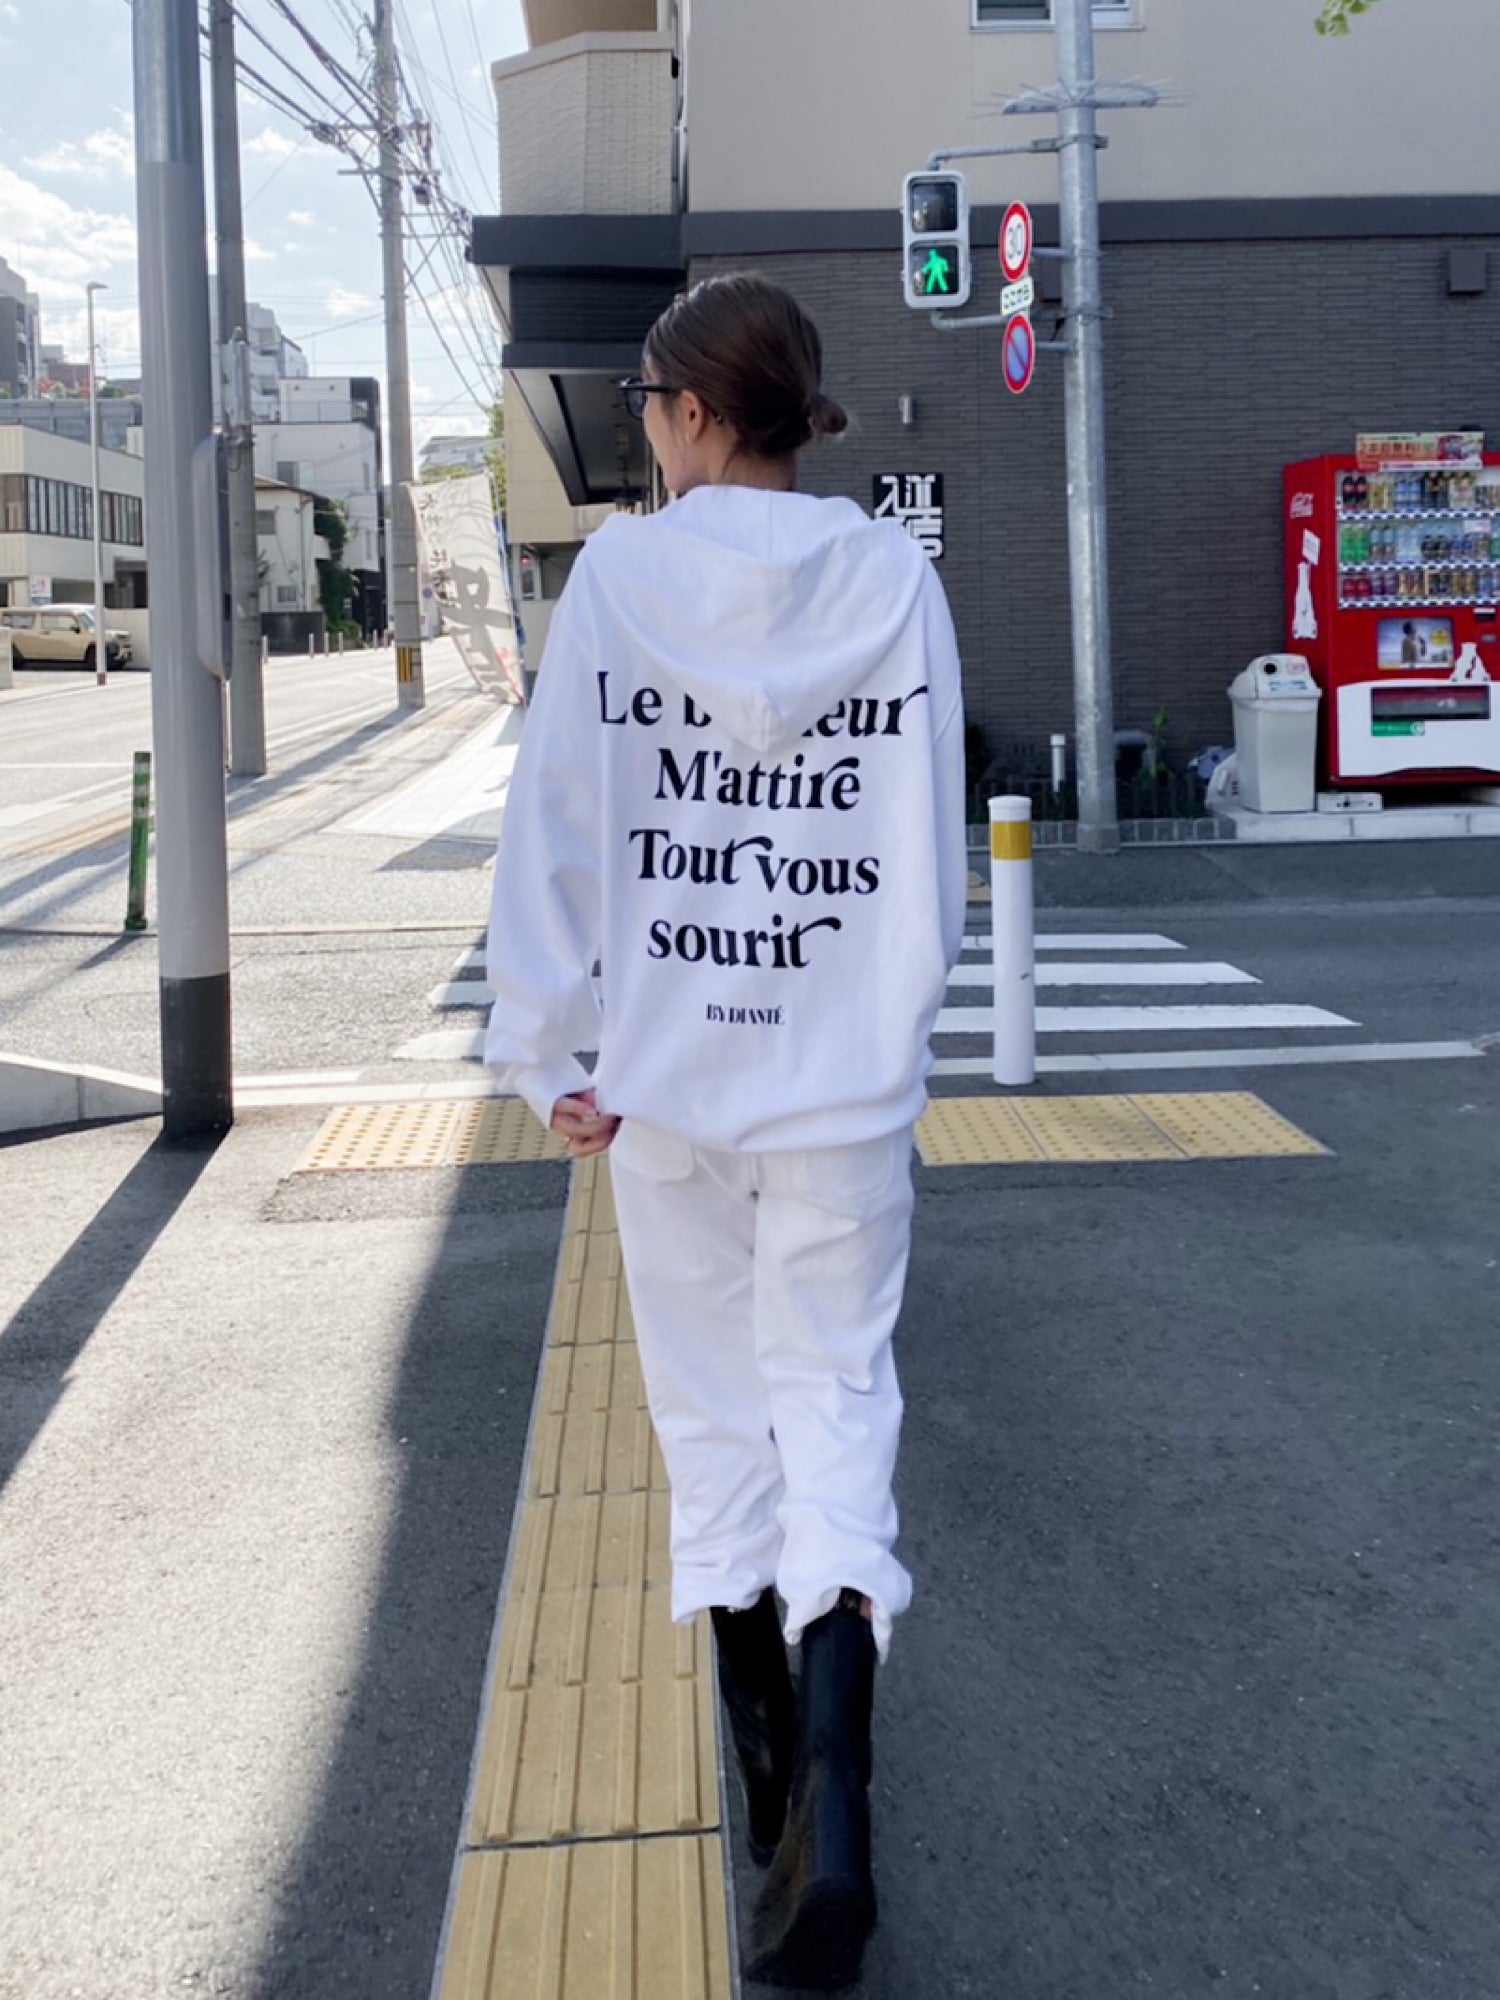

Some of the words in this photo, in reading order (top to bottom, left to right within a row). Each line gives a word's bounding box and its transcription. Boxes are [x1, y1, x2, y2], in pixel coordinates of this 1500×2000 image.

[1007, 221, 1024, 260] 30
[597, 671, 662, 727] Le
[654, 747, 862, 811] M'attire
[628, 828, 773, 885] Tout
[754, 855, 880, 896] vous
[646, 913, 842, 969] sourit
[706, 1003, 726, 1023] BY
